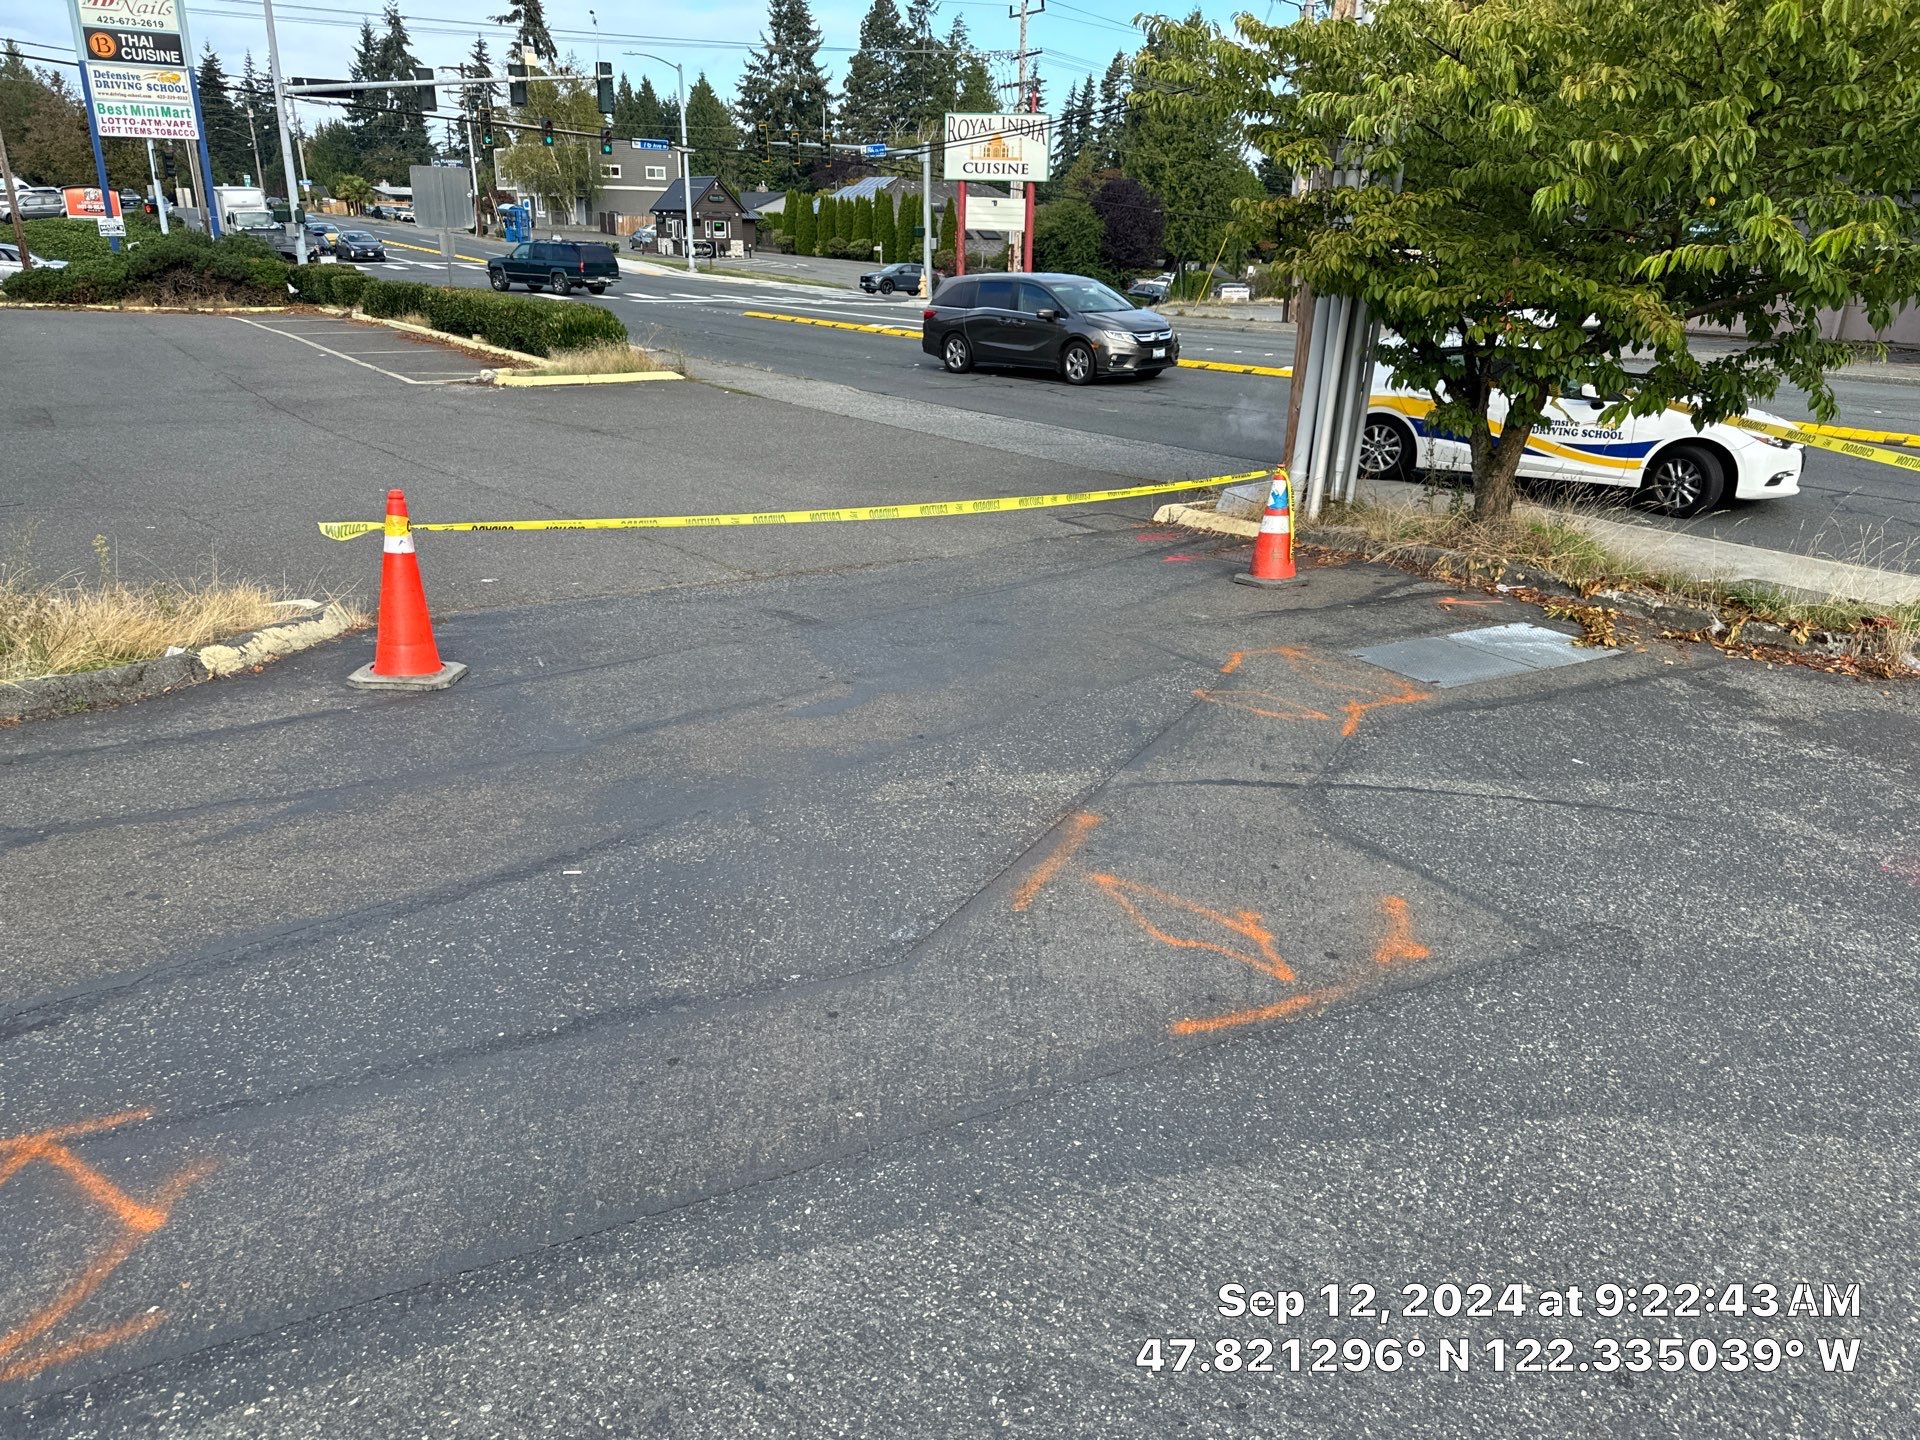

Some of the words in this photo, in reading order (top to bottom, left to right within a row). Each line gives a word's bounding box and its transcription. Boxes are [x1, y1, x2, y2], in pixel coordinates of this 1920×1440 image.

[97, 15, 164, 28] 425-673-2619
[118, 34, 154, 48] THAI
[121, 48, 181, 63] CUISINE
[93, 69, 141, 81] Defensive
[95, 80, 142, 91] DRIVING
[146, 83, 188, 94] SCHOOL
[97, 103, 128, 116] Best
[101, 117, 193, 128] LOTTO-ATM-VAPE
[101, 126, 124, 134] GIFT
[125, 127, 196, 137] ITEMS-TOBACCO
[948, 116, 995, 142] ROYAL
[1002, 116, 1046, 145] INDIA
[963, 162, 1029, 175] CUISINE
[1581, 428, 1624, 440] SCHOOL
